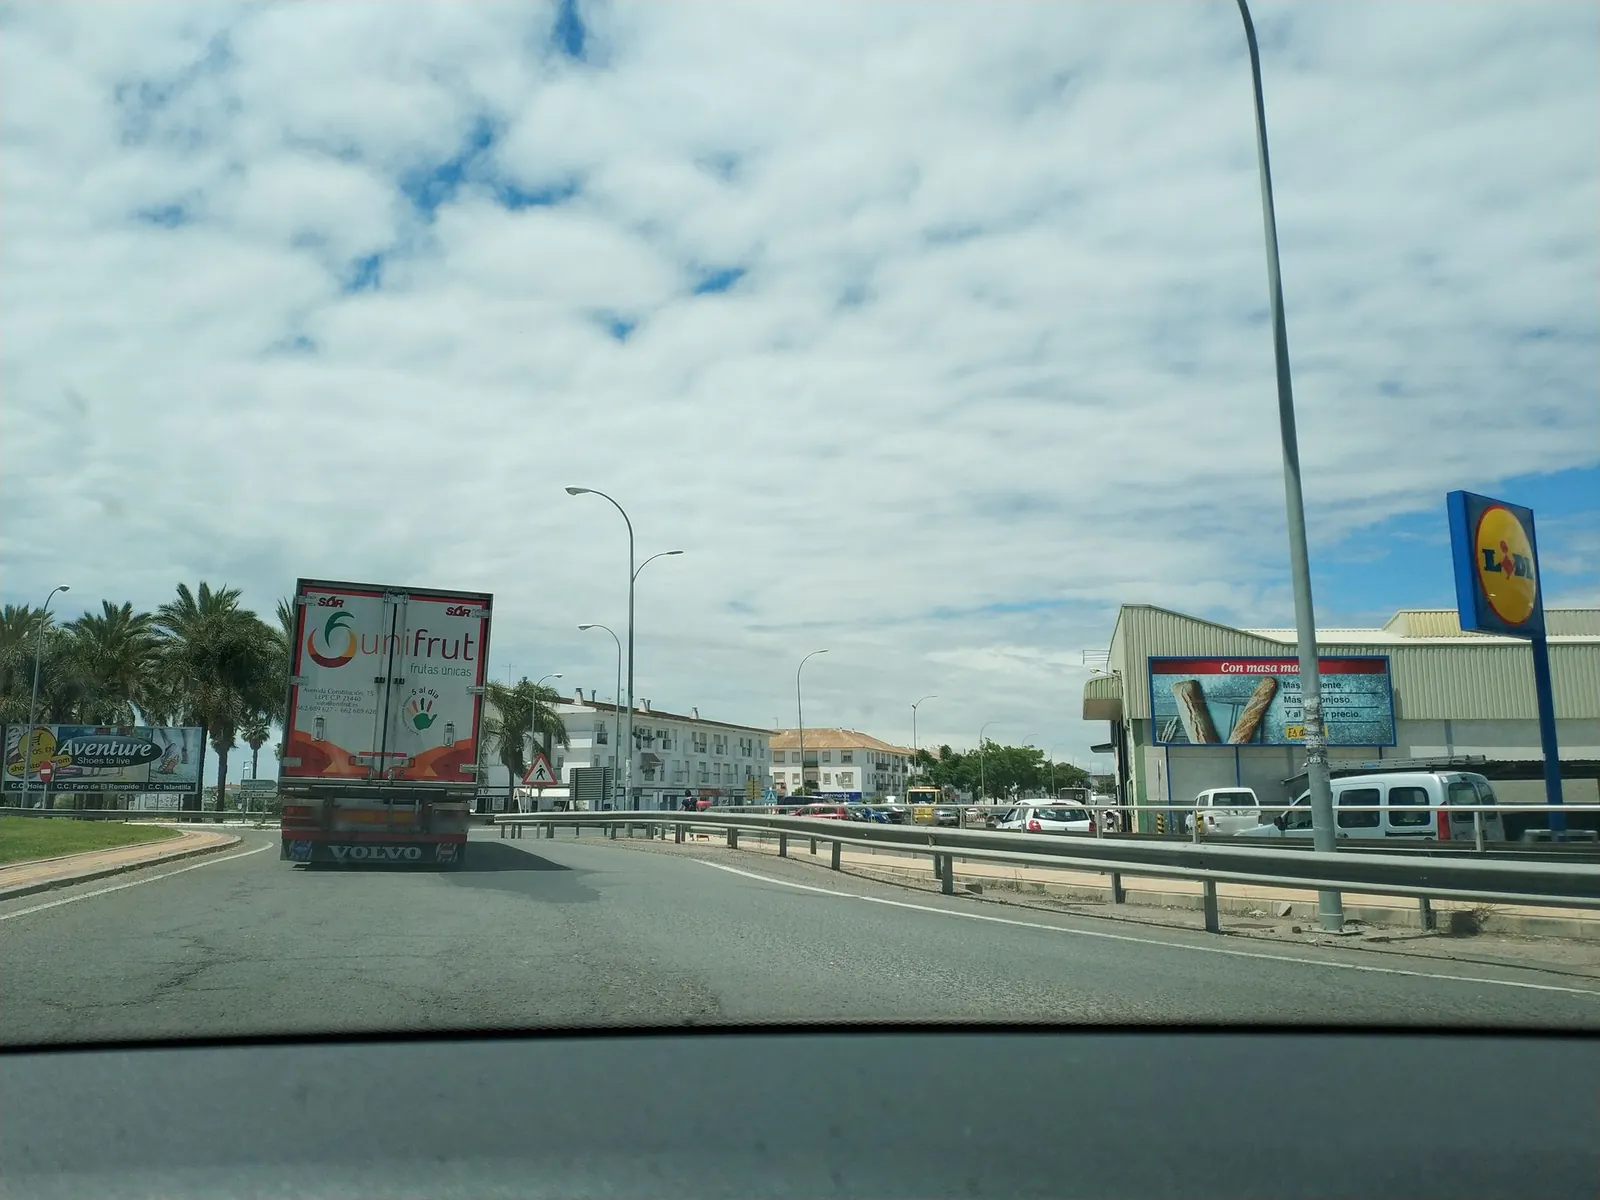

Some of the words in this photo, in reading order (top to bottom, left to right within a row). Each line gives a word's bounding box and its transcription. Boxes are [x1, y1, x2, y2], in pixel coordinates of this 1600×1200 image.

[361, 628, 475, 661] unifrut
[410, 662, 439, 675] frutas
[1221, 662, 1244, 673] Con
[1246, 664, 1278, 673] masa
[1285, 710, 1291, 718] Y
[1331, 710, 1362, 719] precio.
[58, 739, 152, 757] Aventure
[77, 756, 104, 765] Shoes
[106, 757, 114, 765] to
[116, 757, 131, 765] live
[108, 783, 140, 791] Rompido
[328, 845, 422, 860] VOLVO
